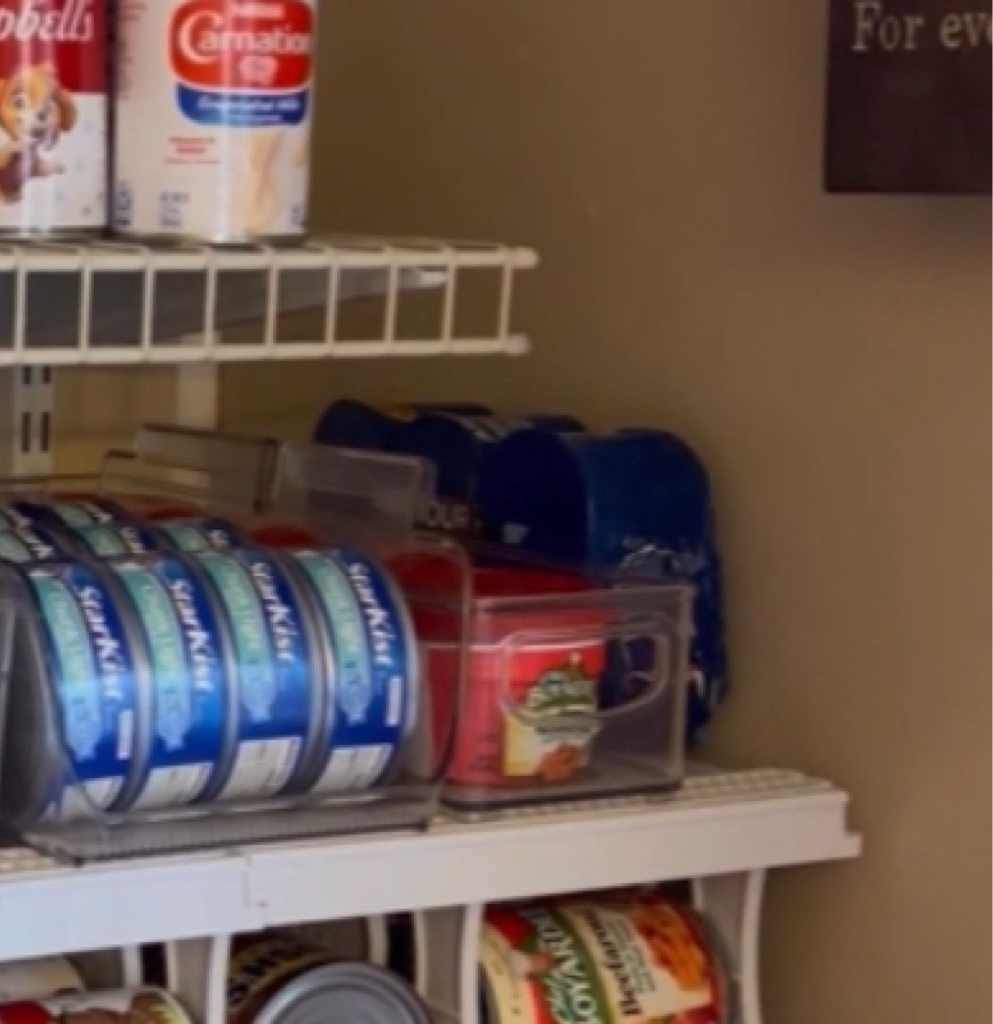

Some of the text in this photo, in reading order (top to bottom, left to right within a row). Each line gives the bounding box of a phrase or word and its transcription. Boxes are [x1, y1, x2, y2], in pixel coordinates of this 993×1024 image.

[852, 1, 925, 52] For
[76, 585, 125, 700] StarKist
[170, 578, 215, 694] StarKist
[252, 561, 296, 664] StarKist
[348, 561, 396, 666] StarKist
